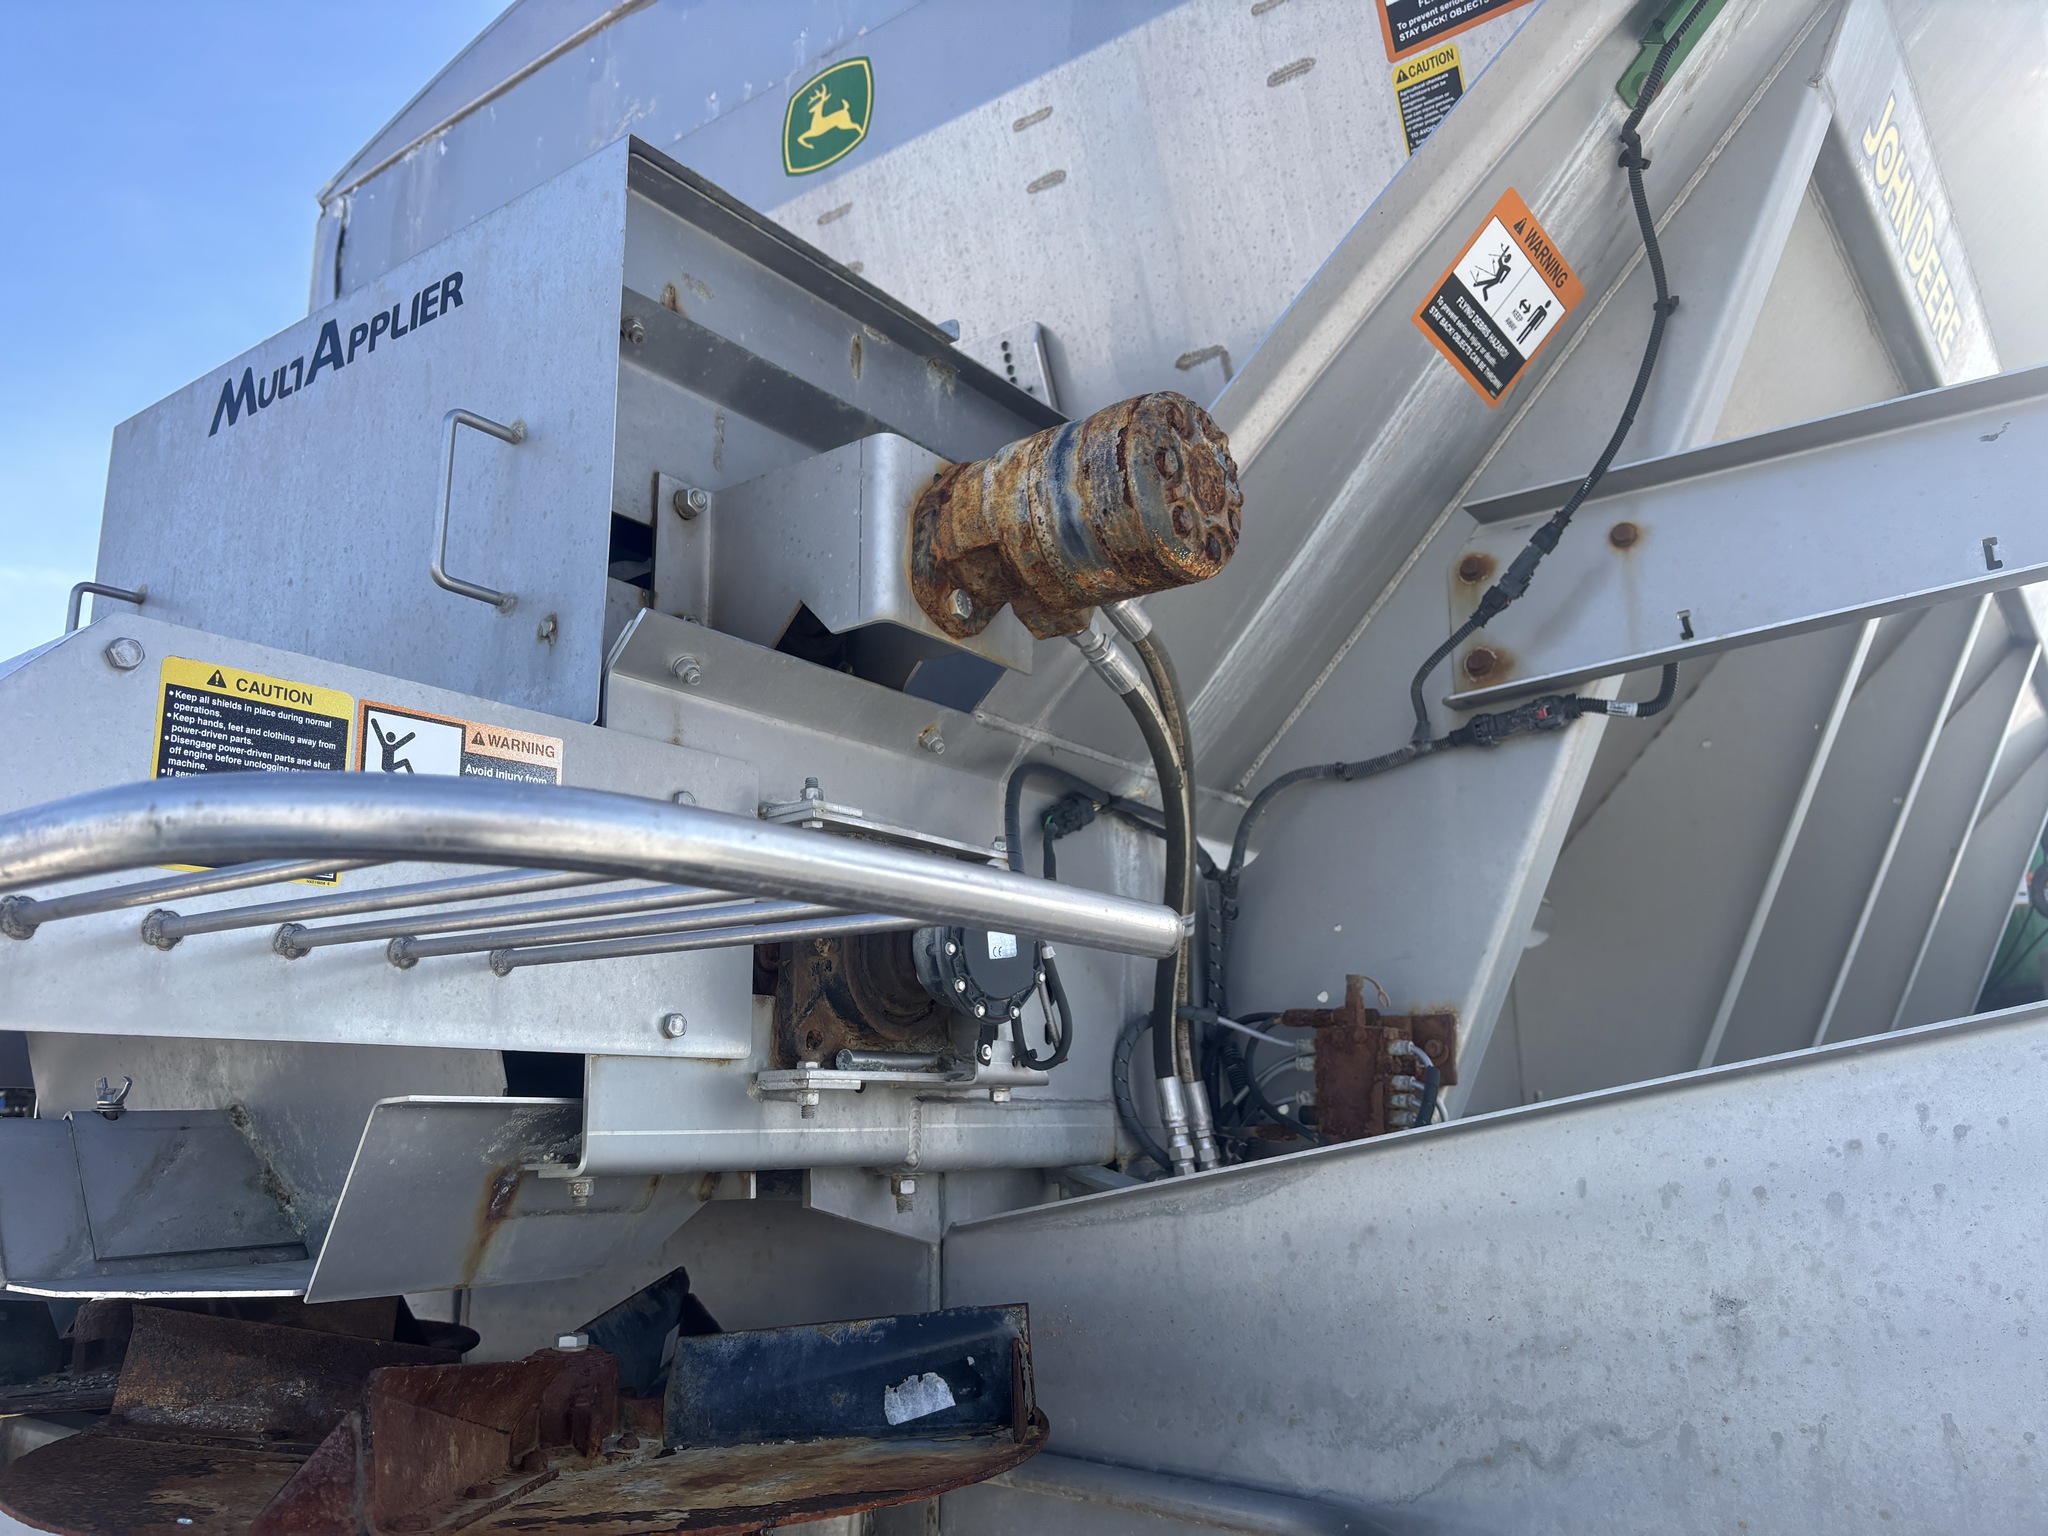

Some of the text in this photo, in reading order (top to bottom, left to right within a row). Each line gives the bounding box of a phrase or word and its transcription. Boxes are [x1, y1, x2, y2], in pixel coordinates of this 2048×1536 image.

[1397, 22, 1407, 30] To
[1408, 7, 1439, 28] prevent
[1440, 0, 1465, 12] serio
[1399, 27, 1420, 42] STAY
[1421, 15, 1448, 32] BACK!
[1408, 48, 1455, 78] CAUTION
[1861, 92, 1963, 363] JOHN DEERE
[1524, 227, 1569, 288] WARNING
[1440, 301, 1459, 324] prevent
[1455, 295, 1475, 319] FLYING
[1471, 313, 1491, 338] DEBRIS
[1427, 304, 1442, 322] STAY
[1451, 331, 1472, 356] OBJECTS
[236, 678, 313, 706] CAUTION
[173, 702, 222, 718] operations.
[175, 690, 332, 728] Keep all shields in place during normal
[171, 725, 254, 746] power-driven parts.
[173, 712, 336, 750] Keep hands, feet and clothing away from
[169, 746, 182, 755] off
[183, 750, 213, 760] engine
[215, 753, 242, 765] before
[170, 734, 330, 770] Disengage power-driven parts and shut
[488, 734, 555, 758] WARNING
[167, 767, 174, 777] If
[168, 758, 208, 771] machine.
[465, 764, 493, 778] Avoid
